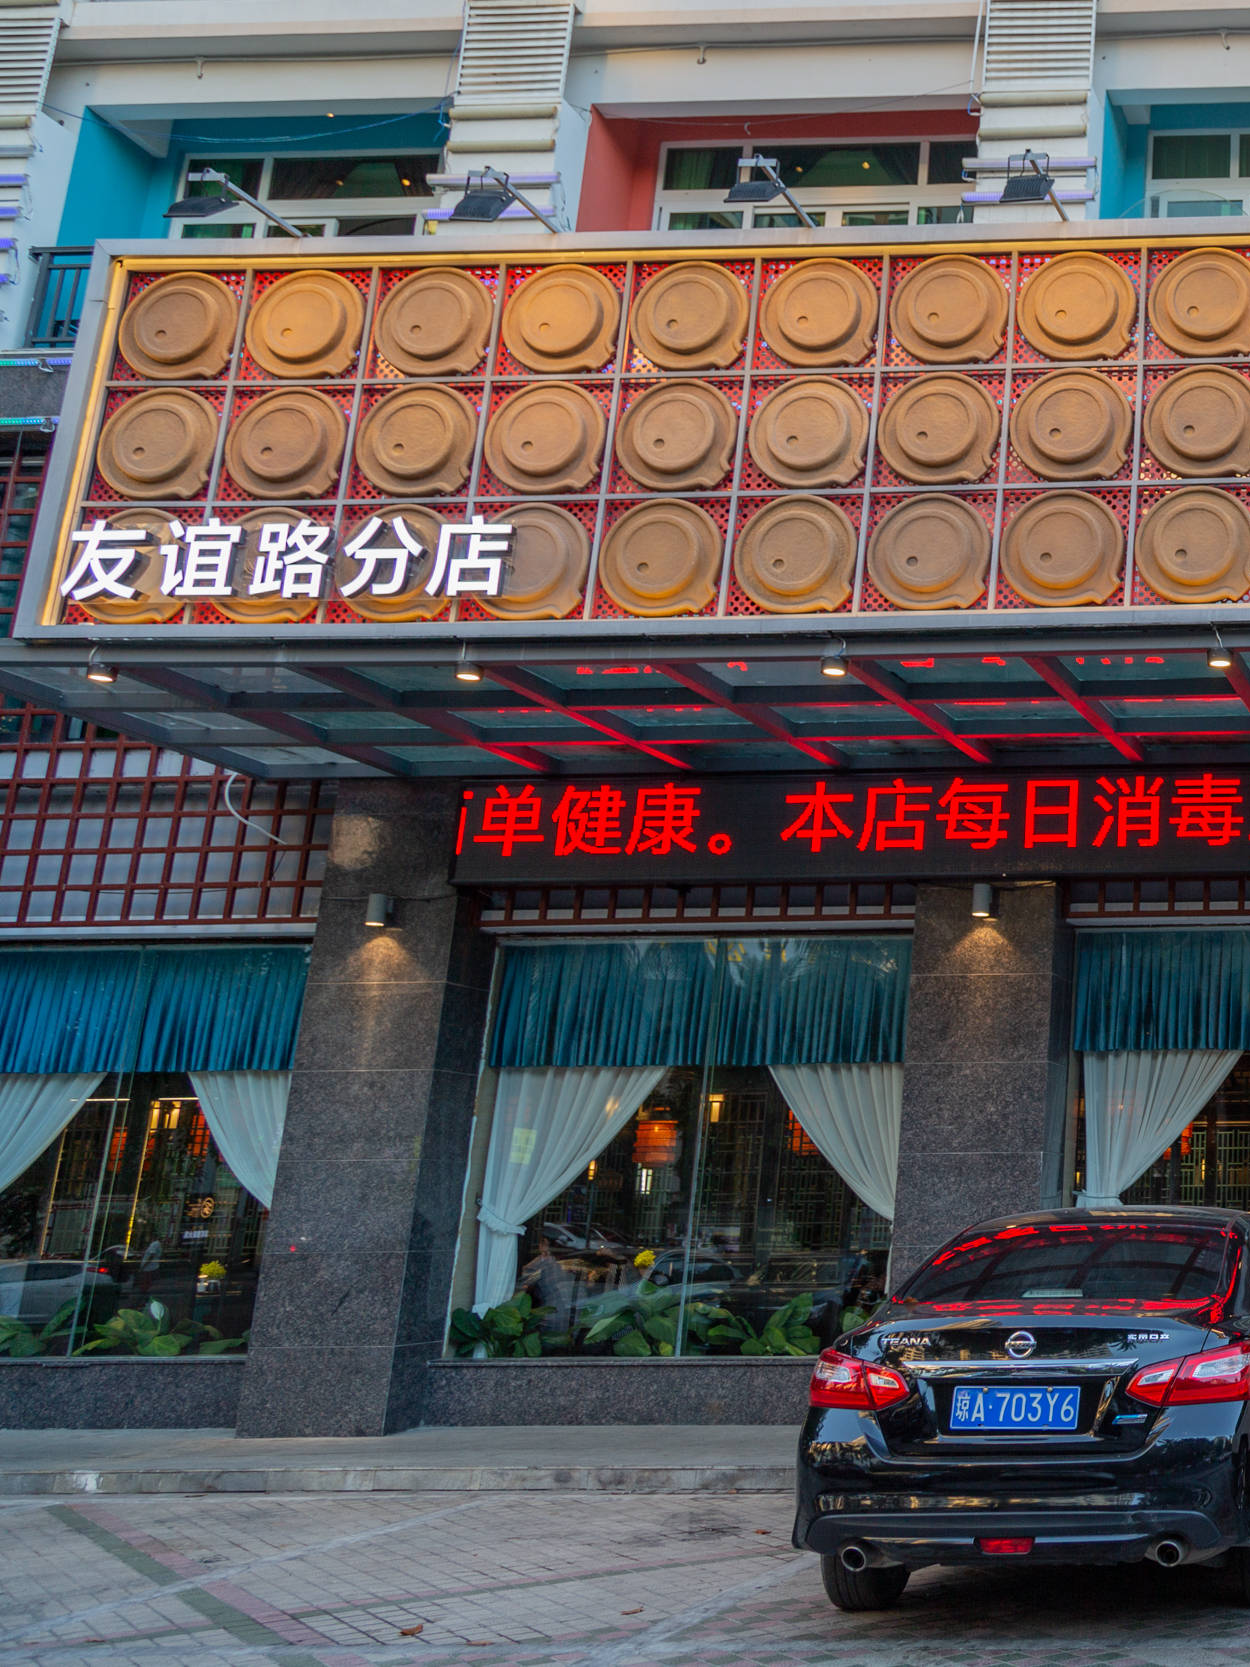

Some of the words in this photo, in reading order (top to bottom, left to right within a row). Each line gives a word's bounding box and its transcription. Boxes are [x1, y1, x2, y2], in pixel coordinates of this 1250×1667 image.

[60, 515, 514, 600] 友谊路分店
[880, 1337, 931, 1347] TEANA
